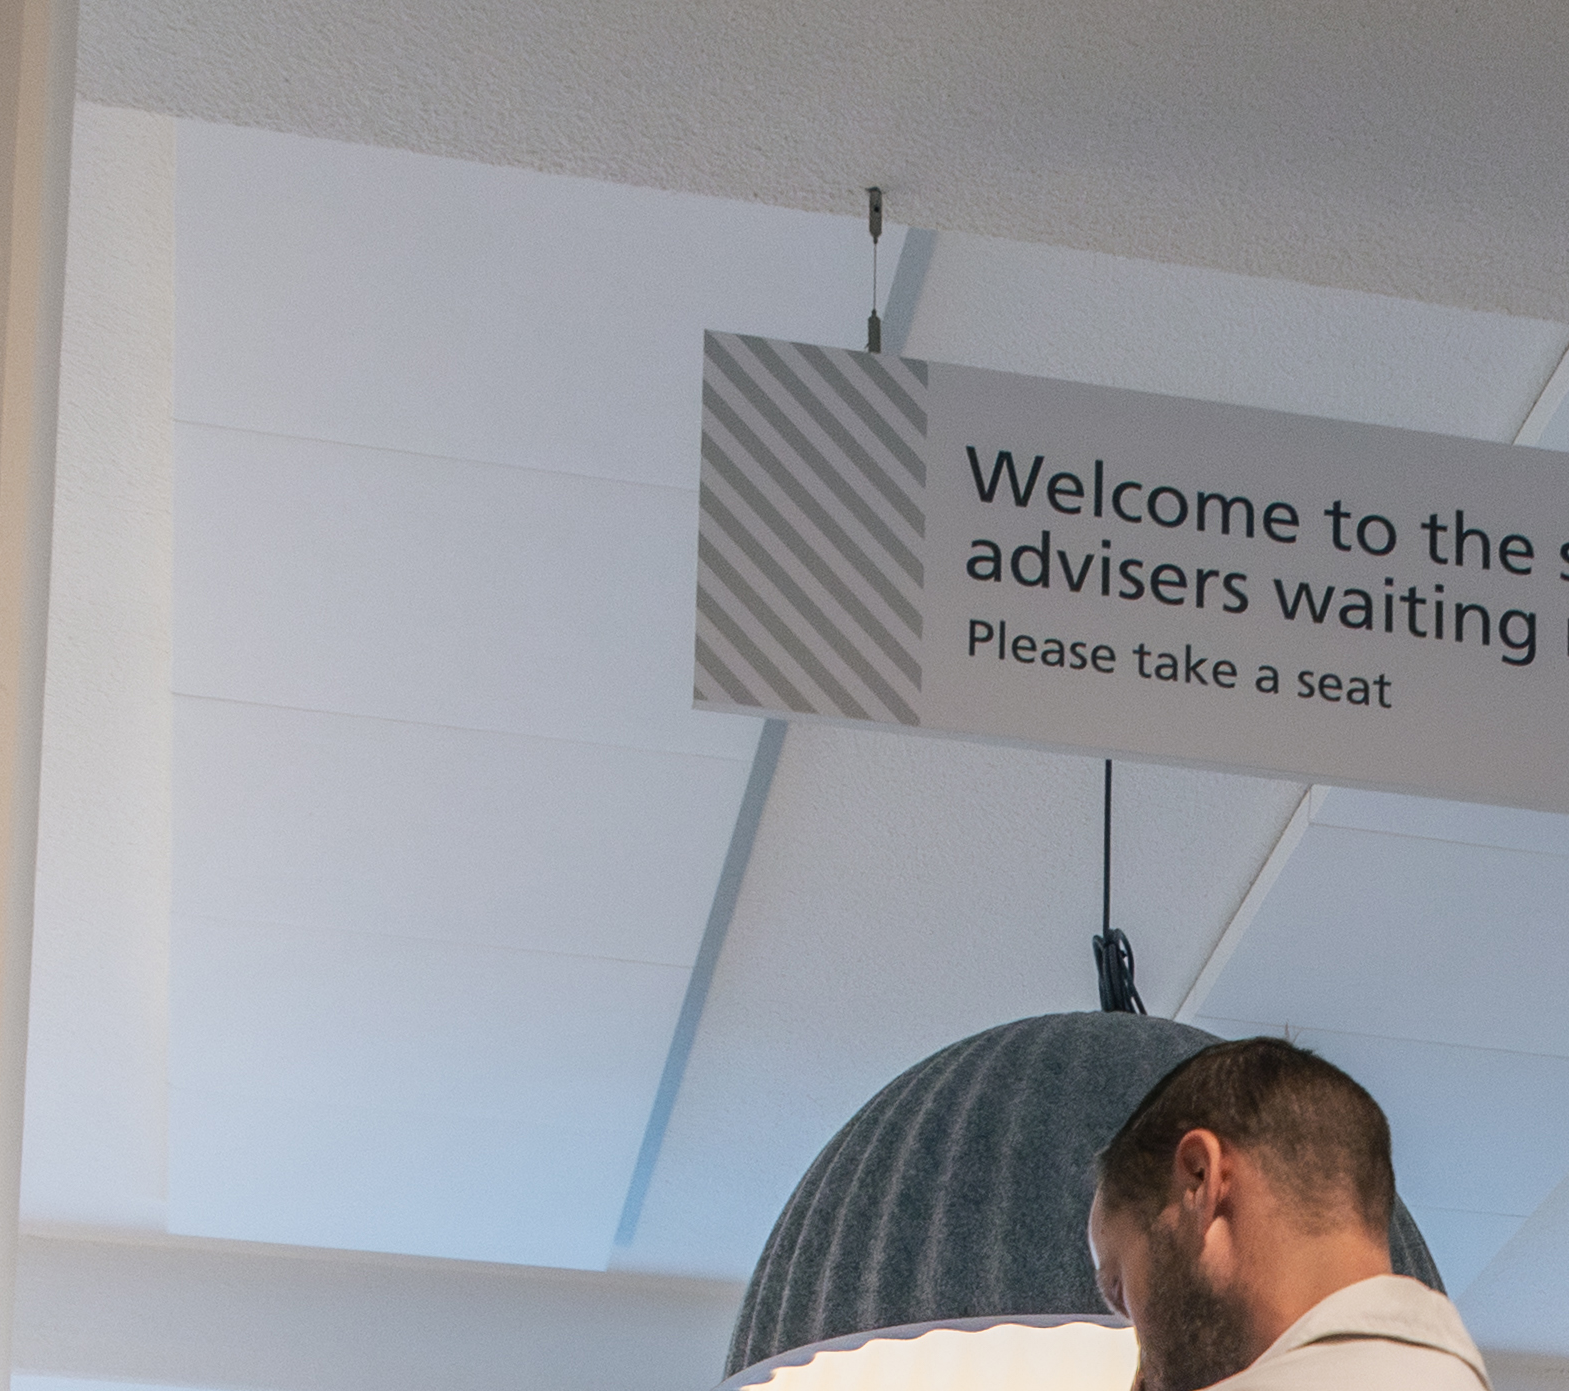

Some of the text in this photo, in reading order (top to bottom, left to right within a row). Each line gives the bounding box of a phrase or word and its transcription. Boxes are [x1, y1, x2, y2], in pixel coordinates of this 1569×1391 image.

[966, 446, 1299, 543] Welcome
[1324, 501, 1396, 556] to
[1421, 510, 1534, 575] the
[967, 530, 1248, 613] advisers
[1274, 577, 1536, 666] waiting
[969, 619, 1391, 708] Please take a seat
